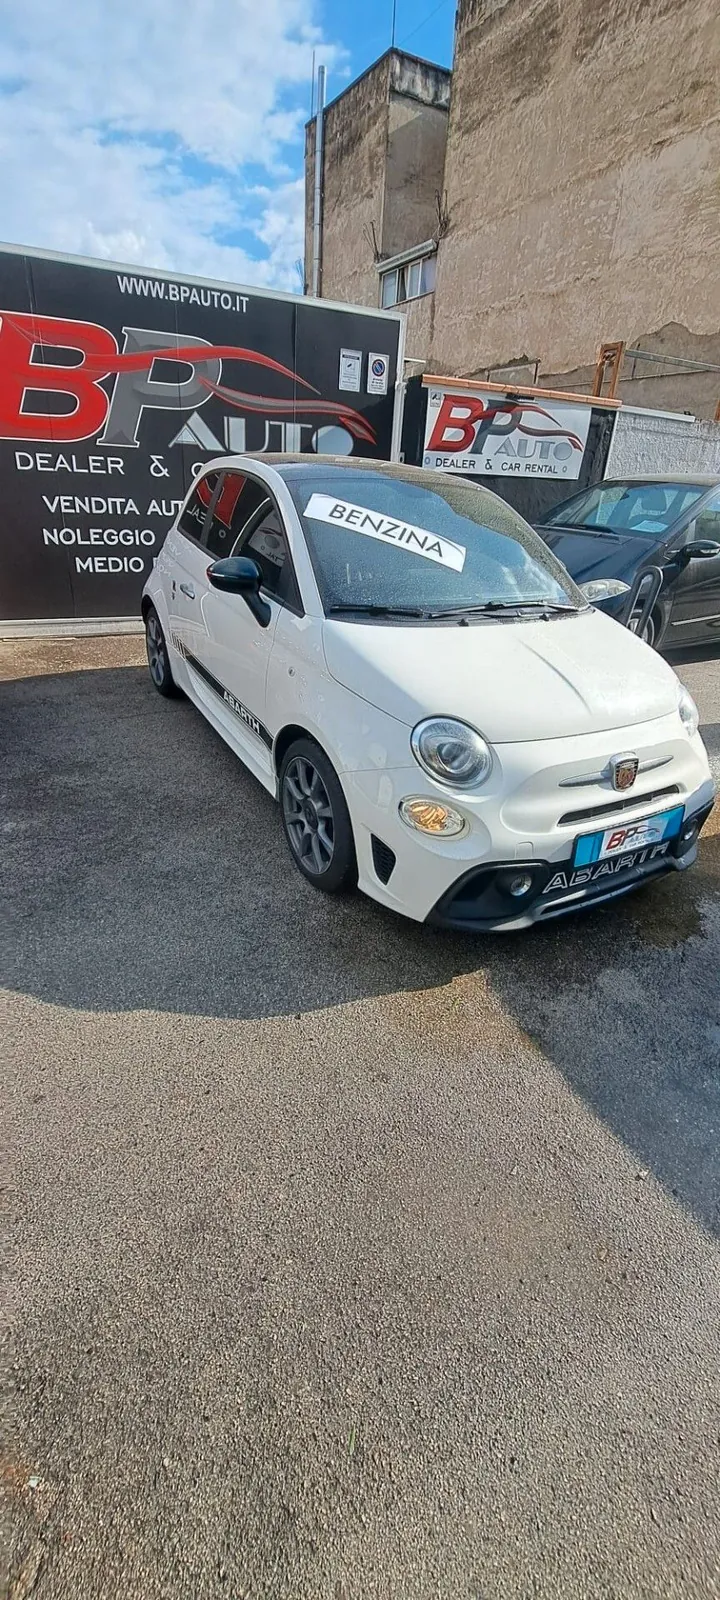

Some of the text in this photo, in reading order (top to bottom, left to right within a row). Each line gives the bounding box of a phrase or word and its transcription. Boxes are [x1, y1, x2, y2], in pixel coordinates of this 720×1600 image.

[116, 274, 249, 313] WWW.BPAUTO.IT
[0, 310, 355, 456] BP AUTO
[425, 393, 573, 461] BP AUTO
[14, 451, 125, 475] DEALER
[149, 455, 170, 477] &
[435, 457, 558, 474] DEALER & CAR RENTAL
[42, 495, 140, 515] VENDITA
[42, 528, 156, 546] NOLEGGIO
[328, 503, 443, 557] BENZINA
[75, 556, 145, 573] MEDIO
[223, 690, 260, 734] ABARTH
[605, 826, 638, 850] BP
[541, 842, 669, 894] ABARTH
